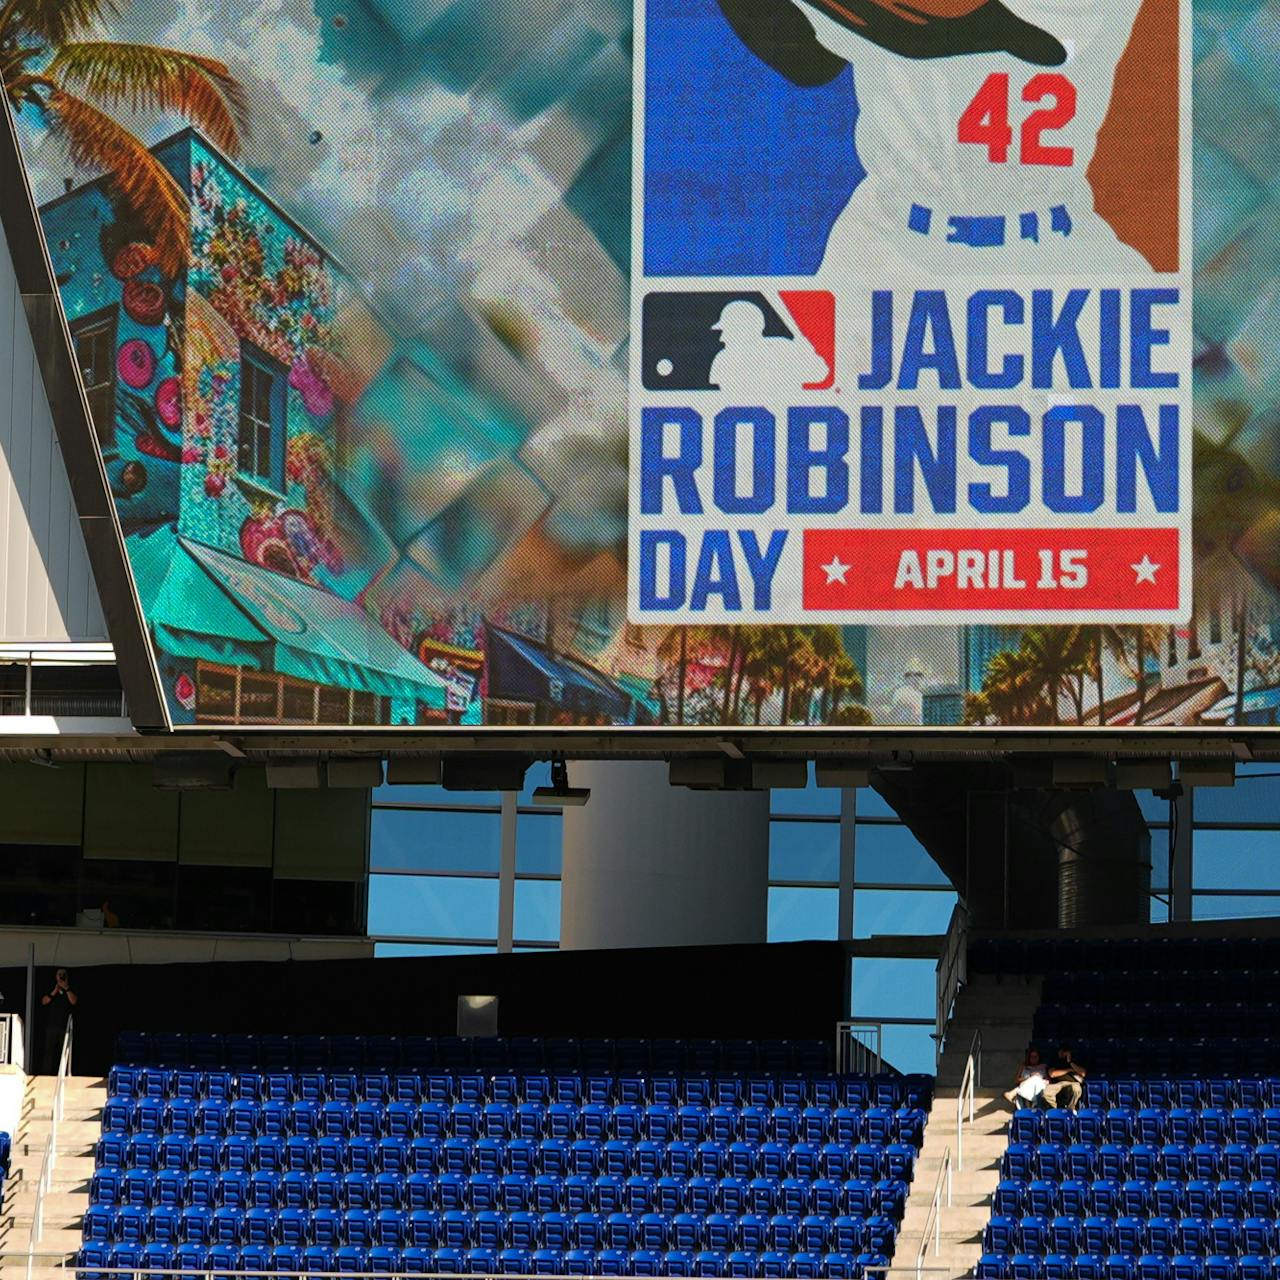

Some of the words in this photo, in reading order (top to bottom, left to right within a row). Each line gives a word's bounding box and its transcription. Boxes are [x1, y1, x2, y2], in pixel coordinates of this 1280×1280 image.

[957, 72, 1078, 167] 42
[857, 288, 1180, 391] JACKIE
[640, 404, 1180, 515] ROBINSON
[638, 529, 789, 611] DAY
[894, 550, 1026, 590] APRIL
[1036, 549, 1089, 589] 15
